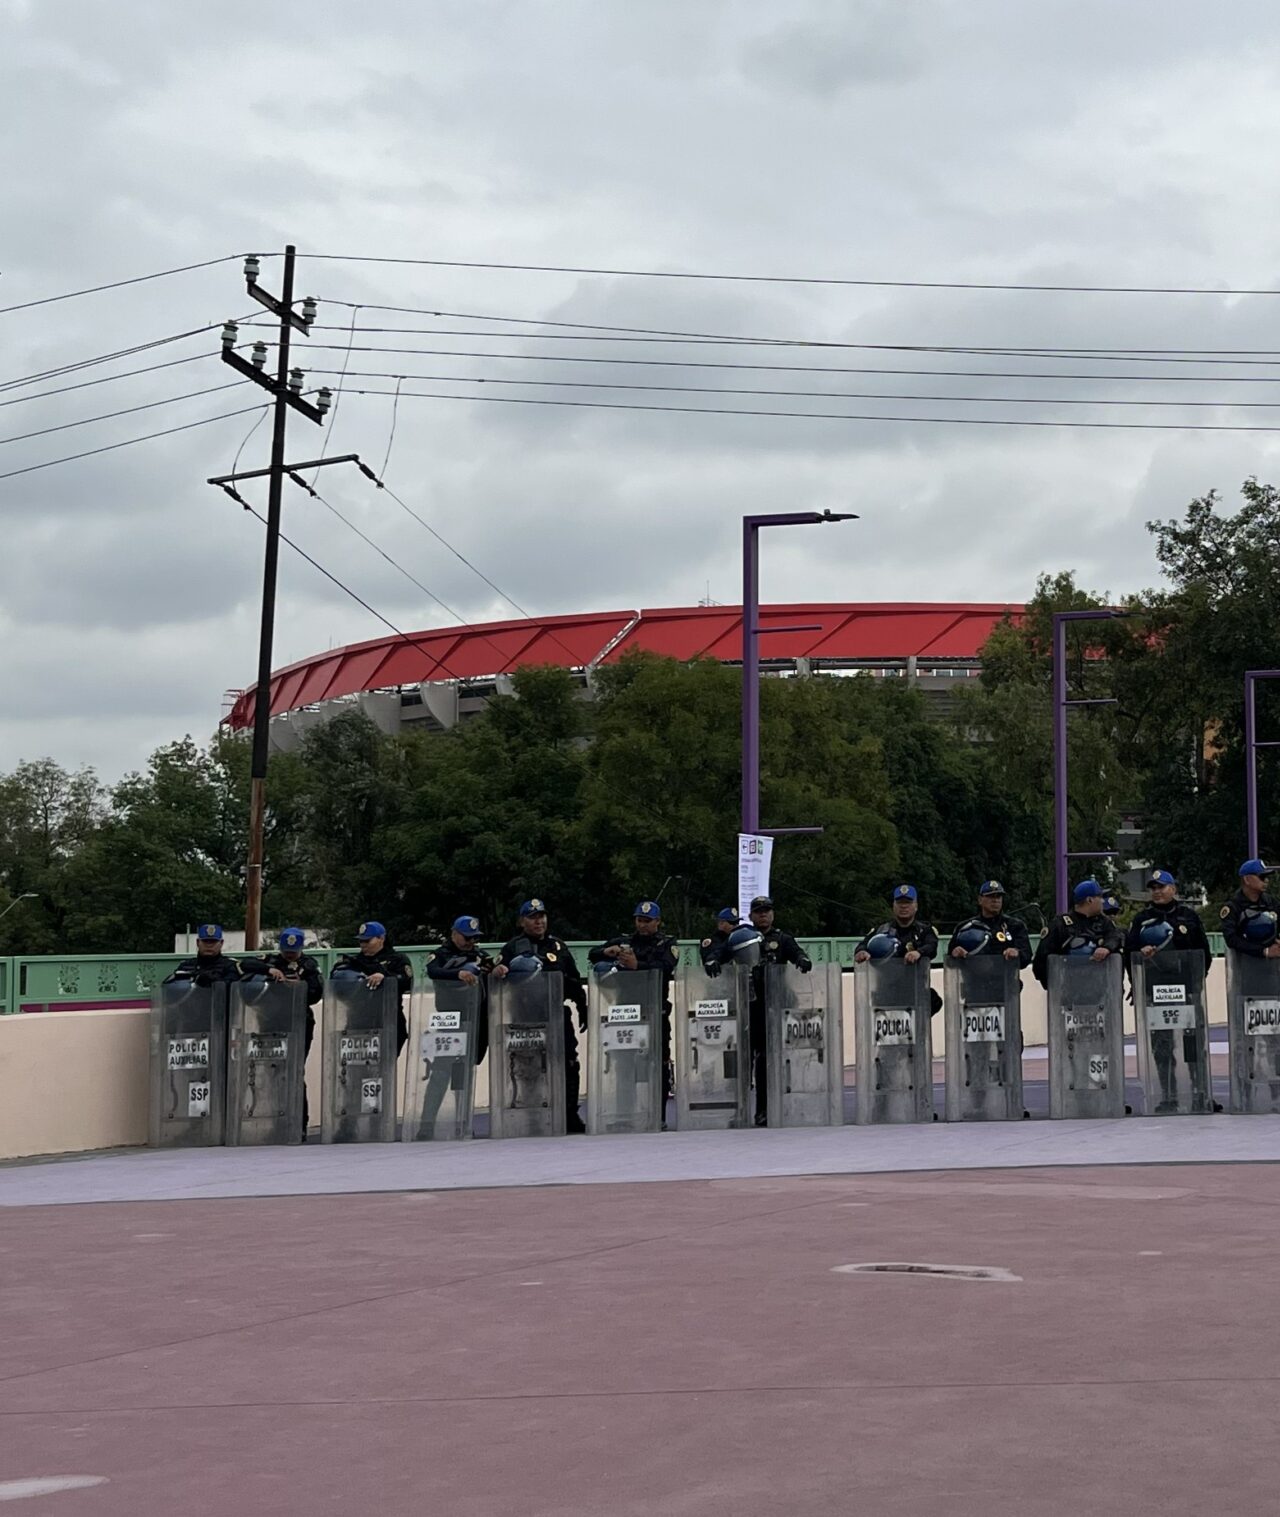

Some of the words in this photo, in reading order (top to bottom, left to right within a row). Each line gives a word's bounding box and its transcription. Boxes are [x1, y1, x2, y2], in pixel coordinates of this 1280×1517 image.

[1162, 1009, 1179, 1018] SSC
[966, 1015, 1000, 1033] POLICIA
[1066, 1014, 1104, 1025] POLICIA
[616, 1029, 634, 1037] SSC
[703, 1025, 721, 1033] SSC
[786, 1022, 822, 1040] POLICIA
[876, 1019, 910, 1036] POLICIA
[341, 1038, 379, 1049] POLICIA
[435, 1037, 452, 1045] SSC
[169, 1042, 207, 1053] POLICIA
[169, 1055, 208, 1065] AUXILIAR
[341, 1051, 379, 1061] AUXILIAR
[1090, 1060, 1108, 1074] SSP
[190, 1088, 209, 1101] SSP
[363, 1084, 382, 1097] SSP
